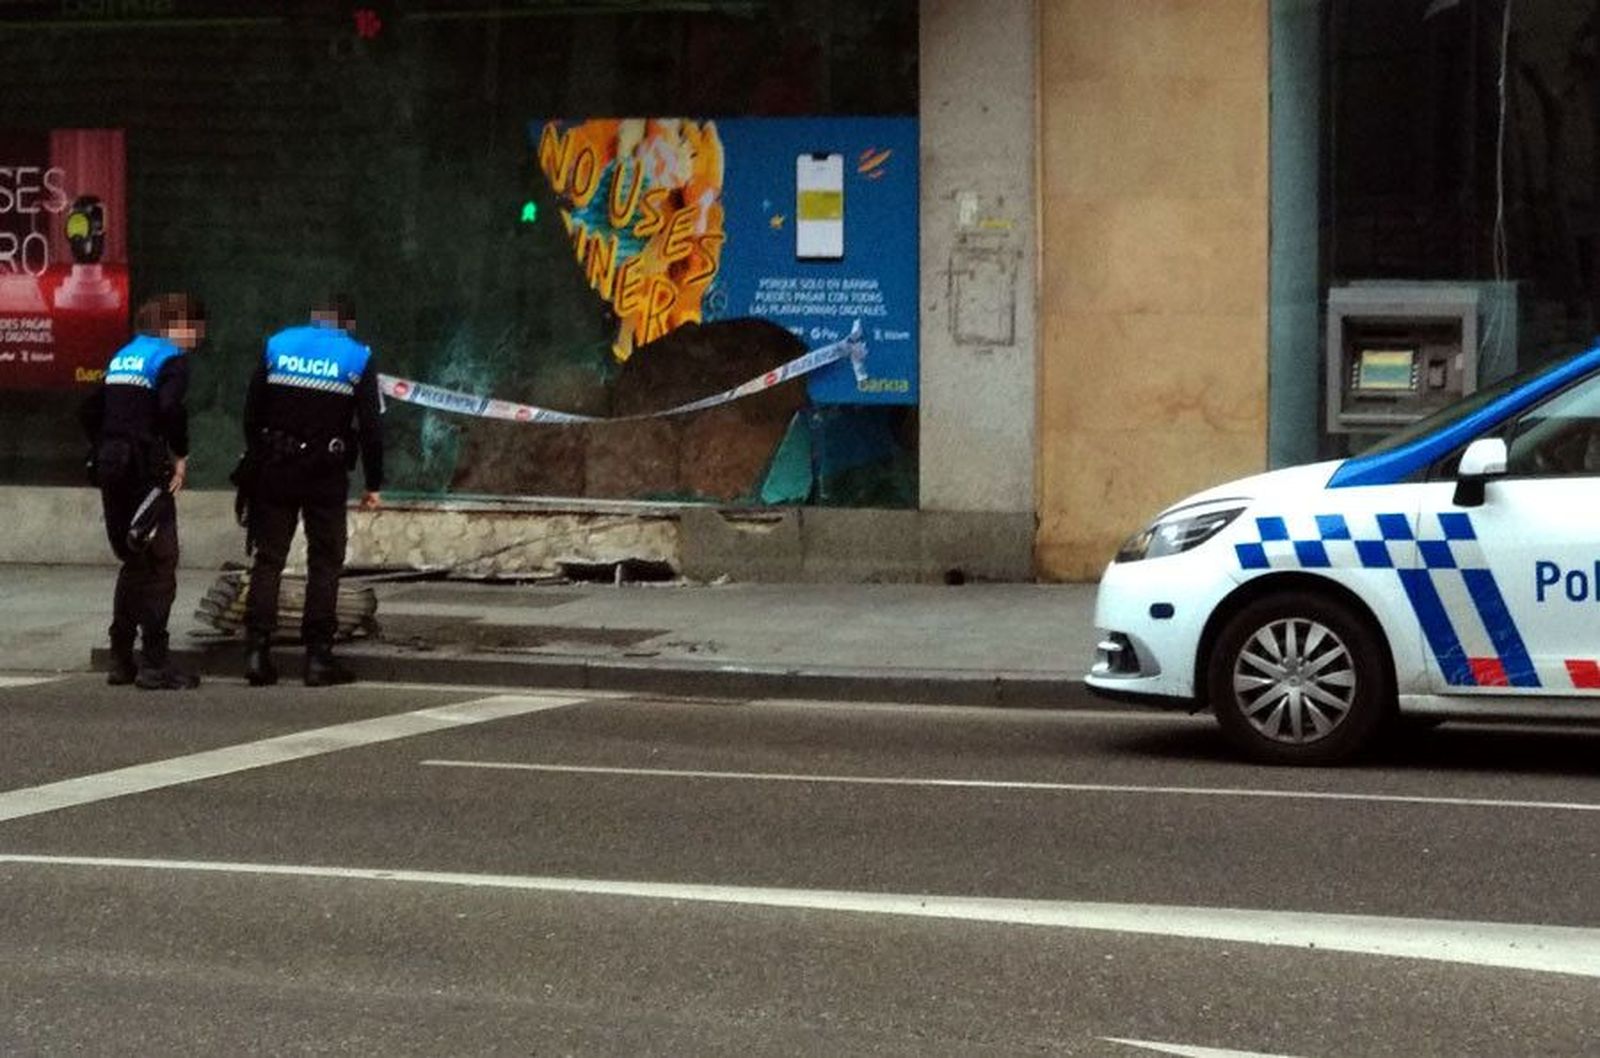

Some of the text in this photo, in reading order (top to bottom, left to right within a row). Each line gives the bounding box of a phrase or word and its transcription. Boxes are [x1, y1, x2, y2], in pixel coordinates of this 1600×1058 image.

[539, 122, 725, 286] NO USES
[277, 354, 339, 378] POLICÍA
[1535, 560, 1600, 602] Pol
